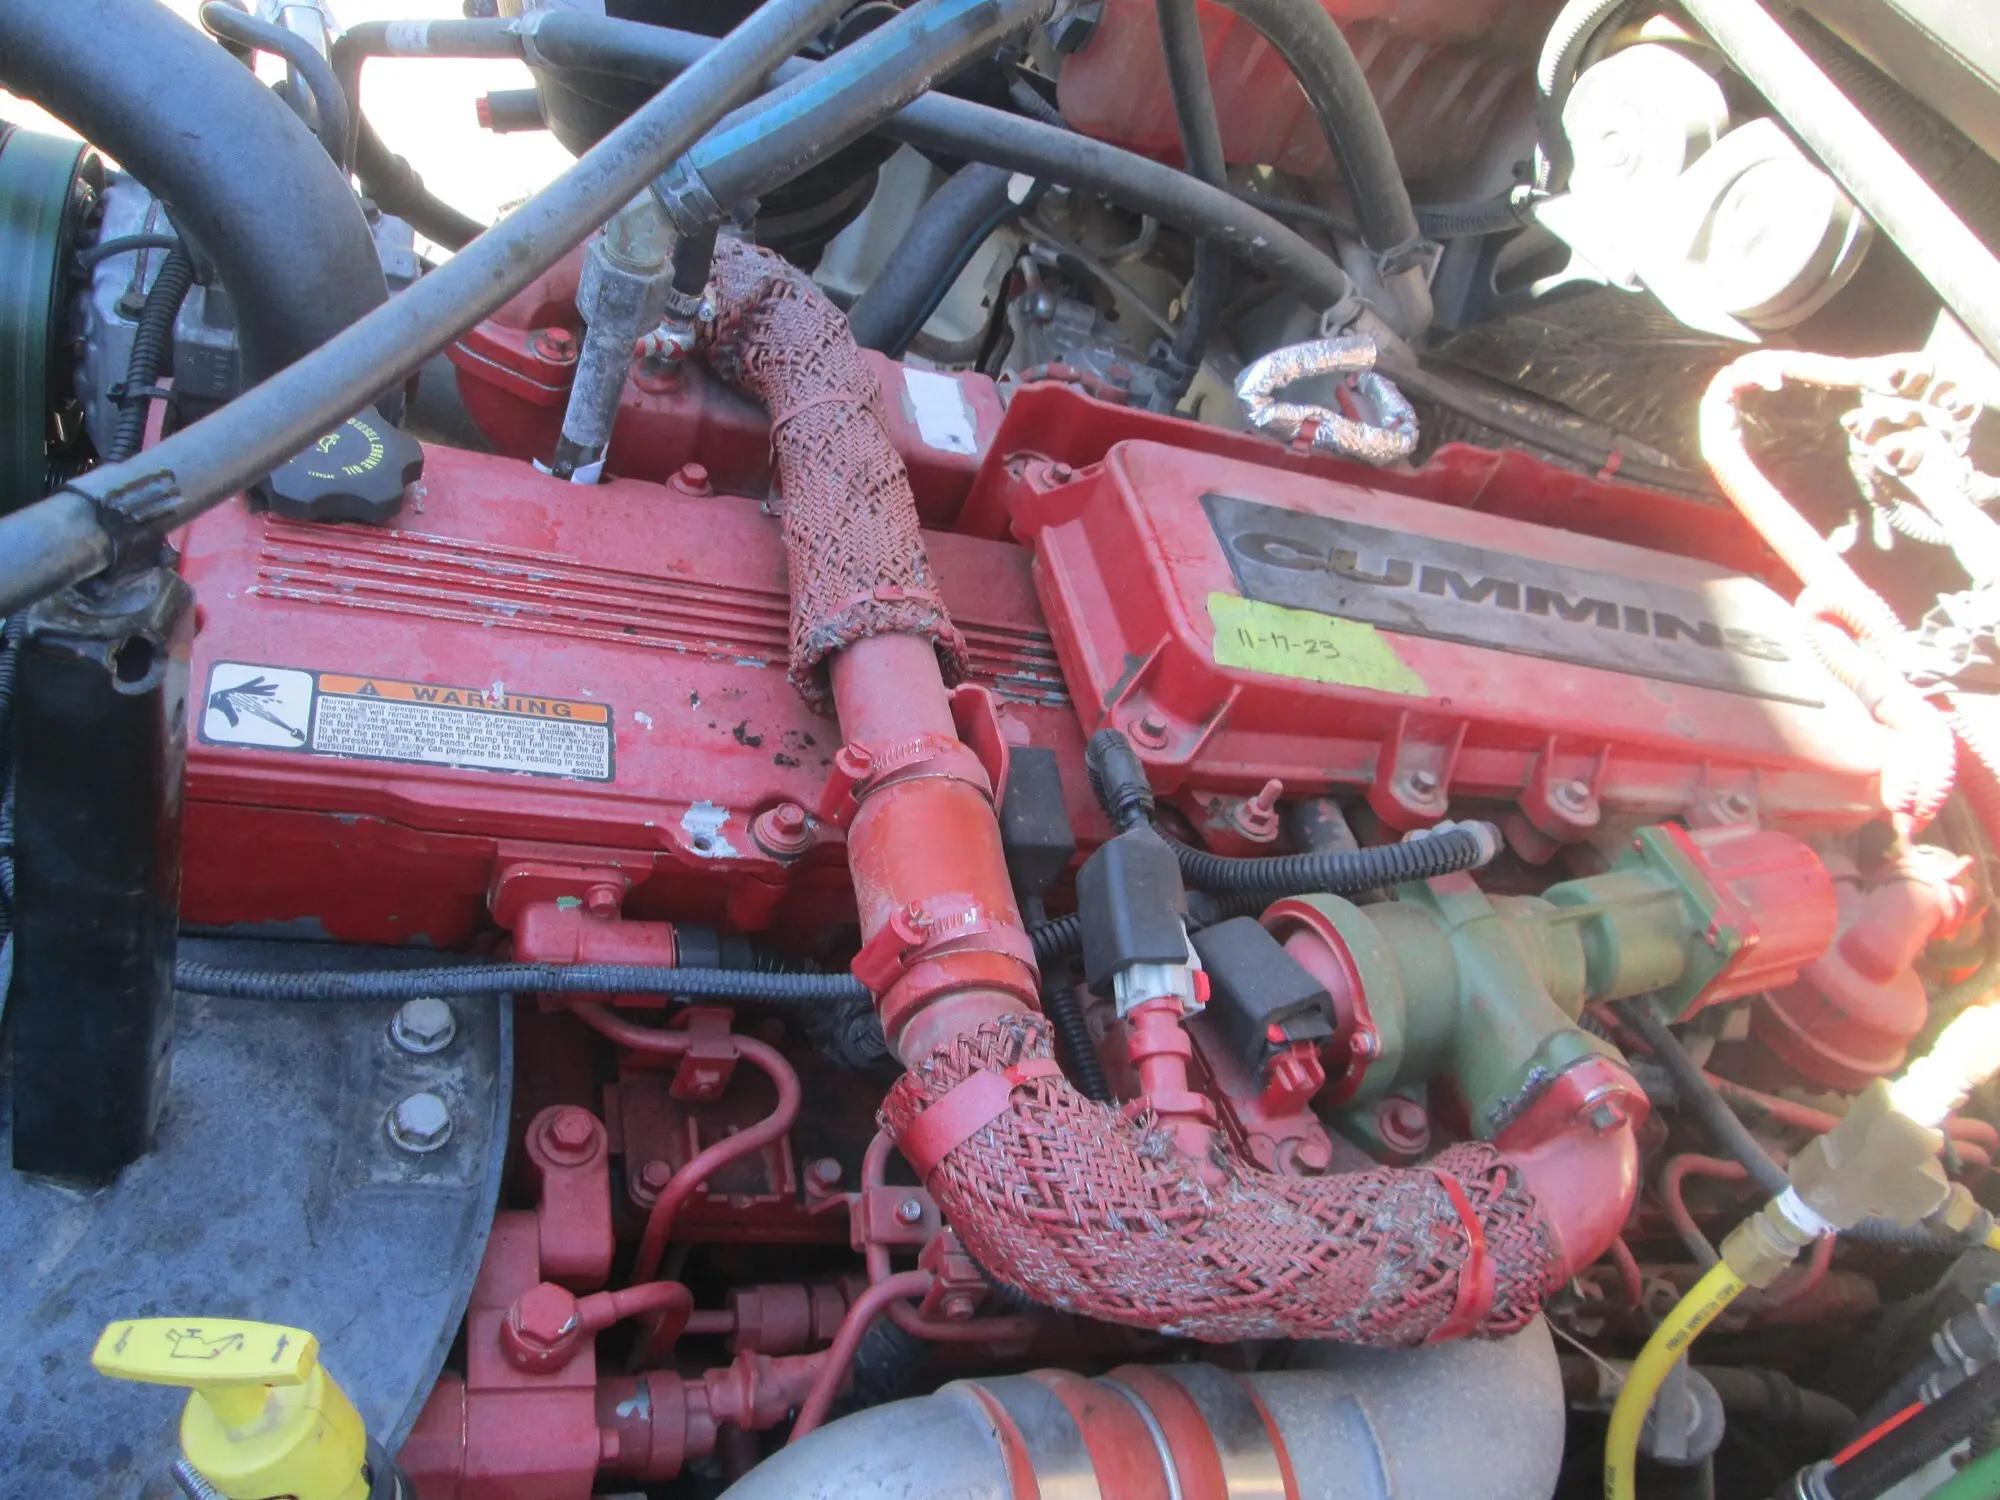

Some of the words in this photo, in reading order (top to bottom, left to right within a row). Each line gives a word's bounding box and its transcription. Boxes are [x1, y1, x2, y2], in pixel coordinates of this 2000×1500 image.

[341, 464, 364, 476] OIL
[360, 443, 384, 470] ENGINE
[1231, 531, 1790, 663] CUMMINS
[1237, 627, 1341, 659] 11-17-23
[371, 733, 410, 743] presure.
